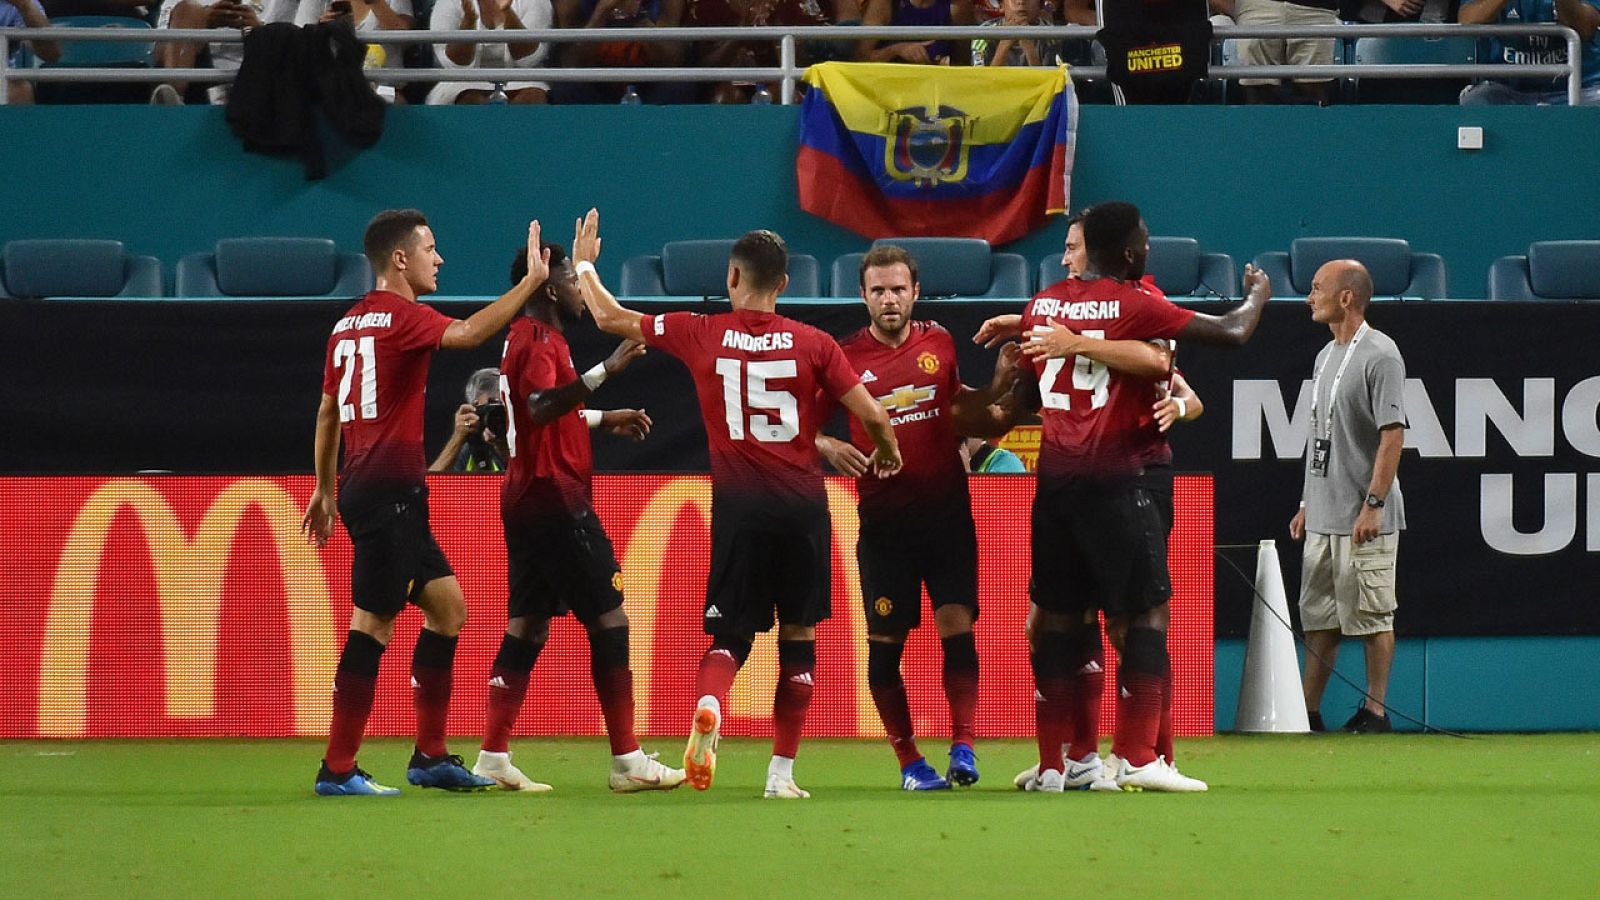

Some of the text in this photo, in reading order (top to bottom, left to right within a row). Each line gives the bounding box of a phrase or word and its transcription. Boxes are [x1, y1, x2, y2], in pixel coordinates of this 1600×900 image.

[1127, 46, 1181, 58] MANCHESTER
[1529, 34, 1548, 49] Fly
[1127, 54, 1183, 71] UNITED
[1031, 298, 1120, 320] FSU-MENSAH
[722, 329, 794, 352] ANDREAS
[1030, 325, 1111, 411] 24
[333, 336, 378, 423] 21
[715, 357, 800, 443] 15
[890, 408, 940, 426] EVROLET
